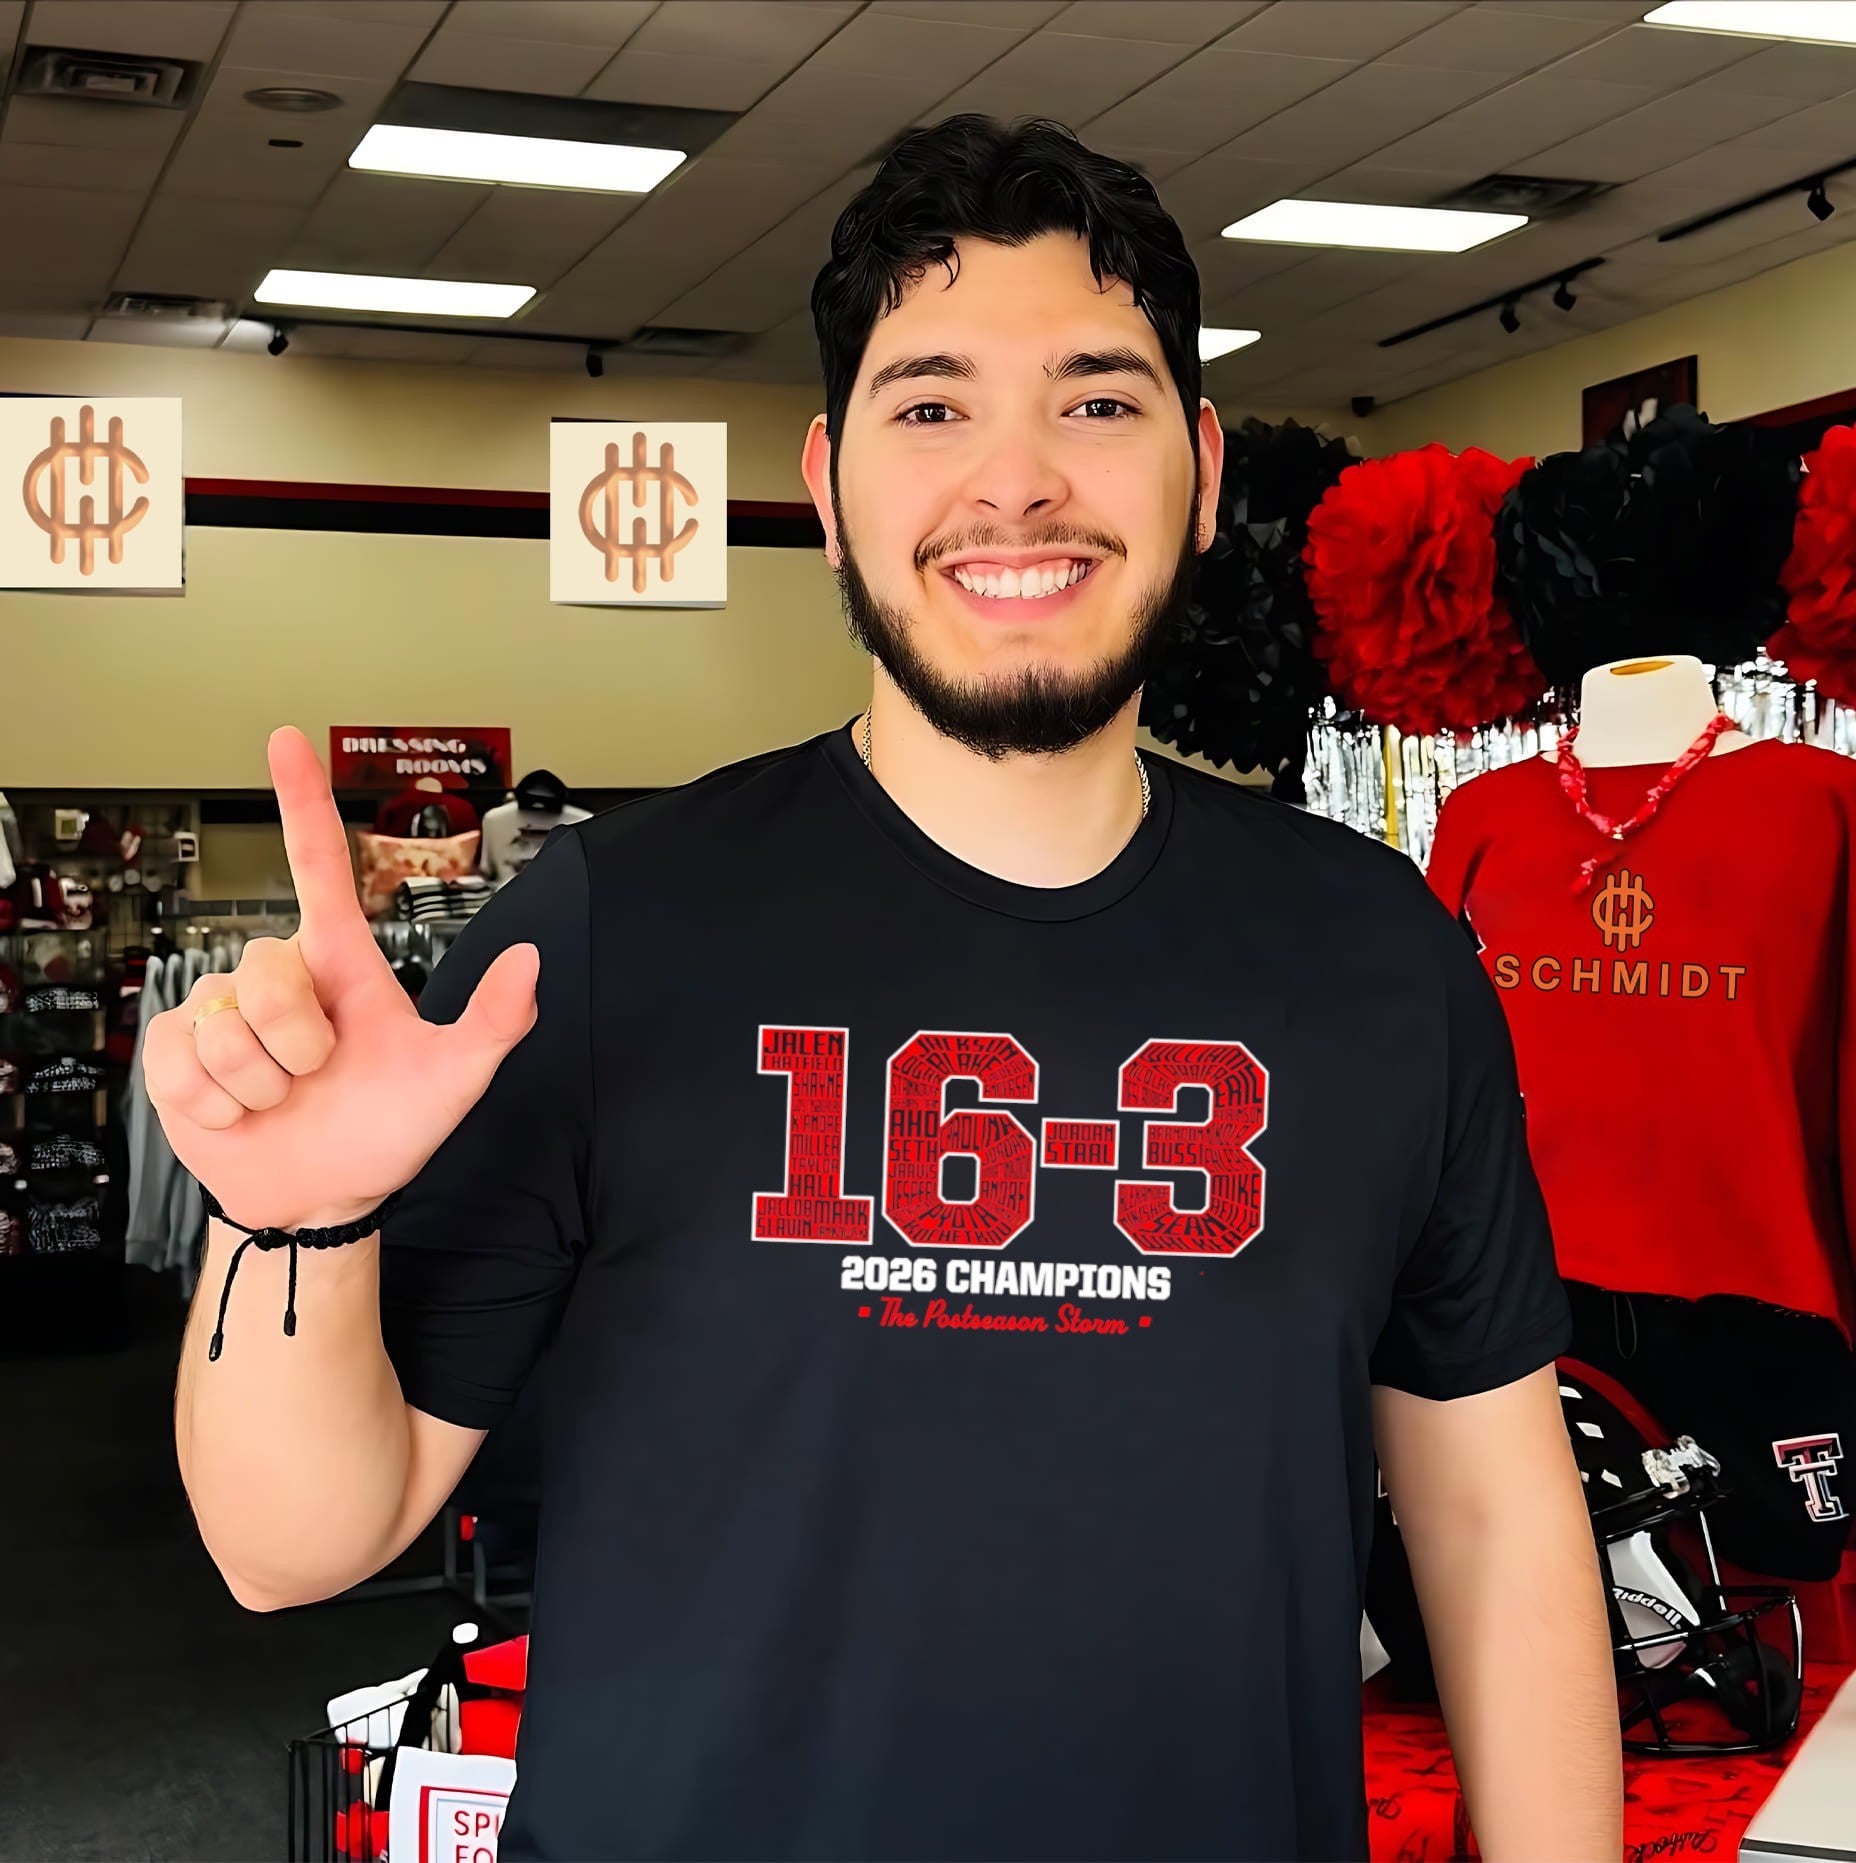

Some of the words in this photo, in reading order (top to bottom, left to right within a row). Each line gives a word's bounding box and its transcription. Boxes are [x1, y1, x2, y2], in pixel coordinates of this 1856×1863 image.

[1493, 953, 1747, 1001] SCHMIDT
[763, 1032, 843, 1056] JALEN
[891, 1110, 938, 1137] AHO
[890, 1139, 937, 1162] SETH
[790, 1174, 838, 1198] HALL
[1212, 1173, 1260, 1209] MIKE
[814, 1200, 869, 1226] MARK
[841, 1255, 938, 1293] 2026
[945, 1258, 1172, 1301] CHAMPIONS
[880, 1296, 919, 1328] The
[922, 1298, 1050, 1333] Postseason
[1054, 1303, 1129, 1336] Storm
